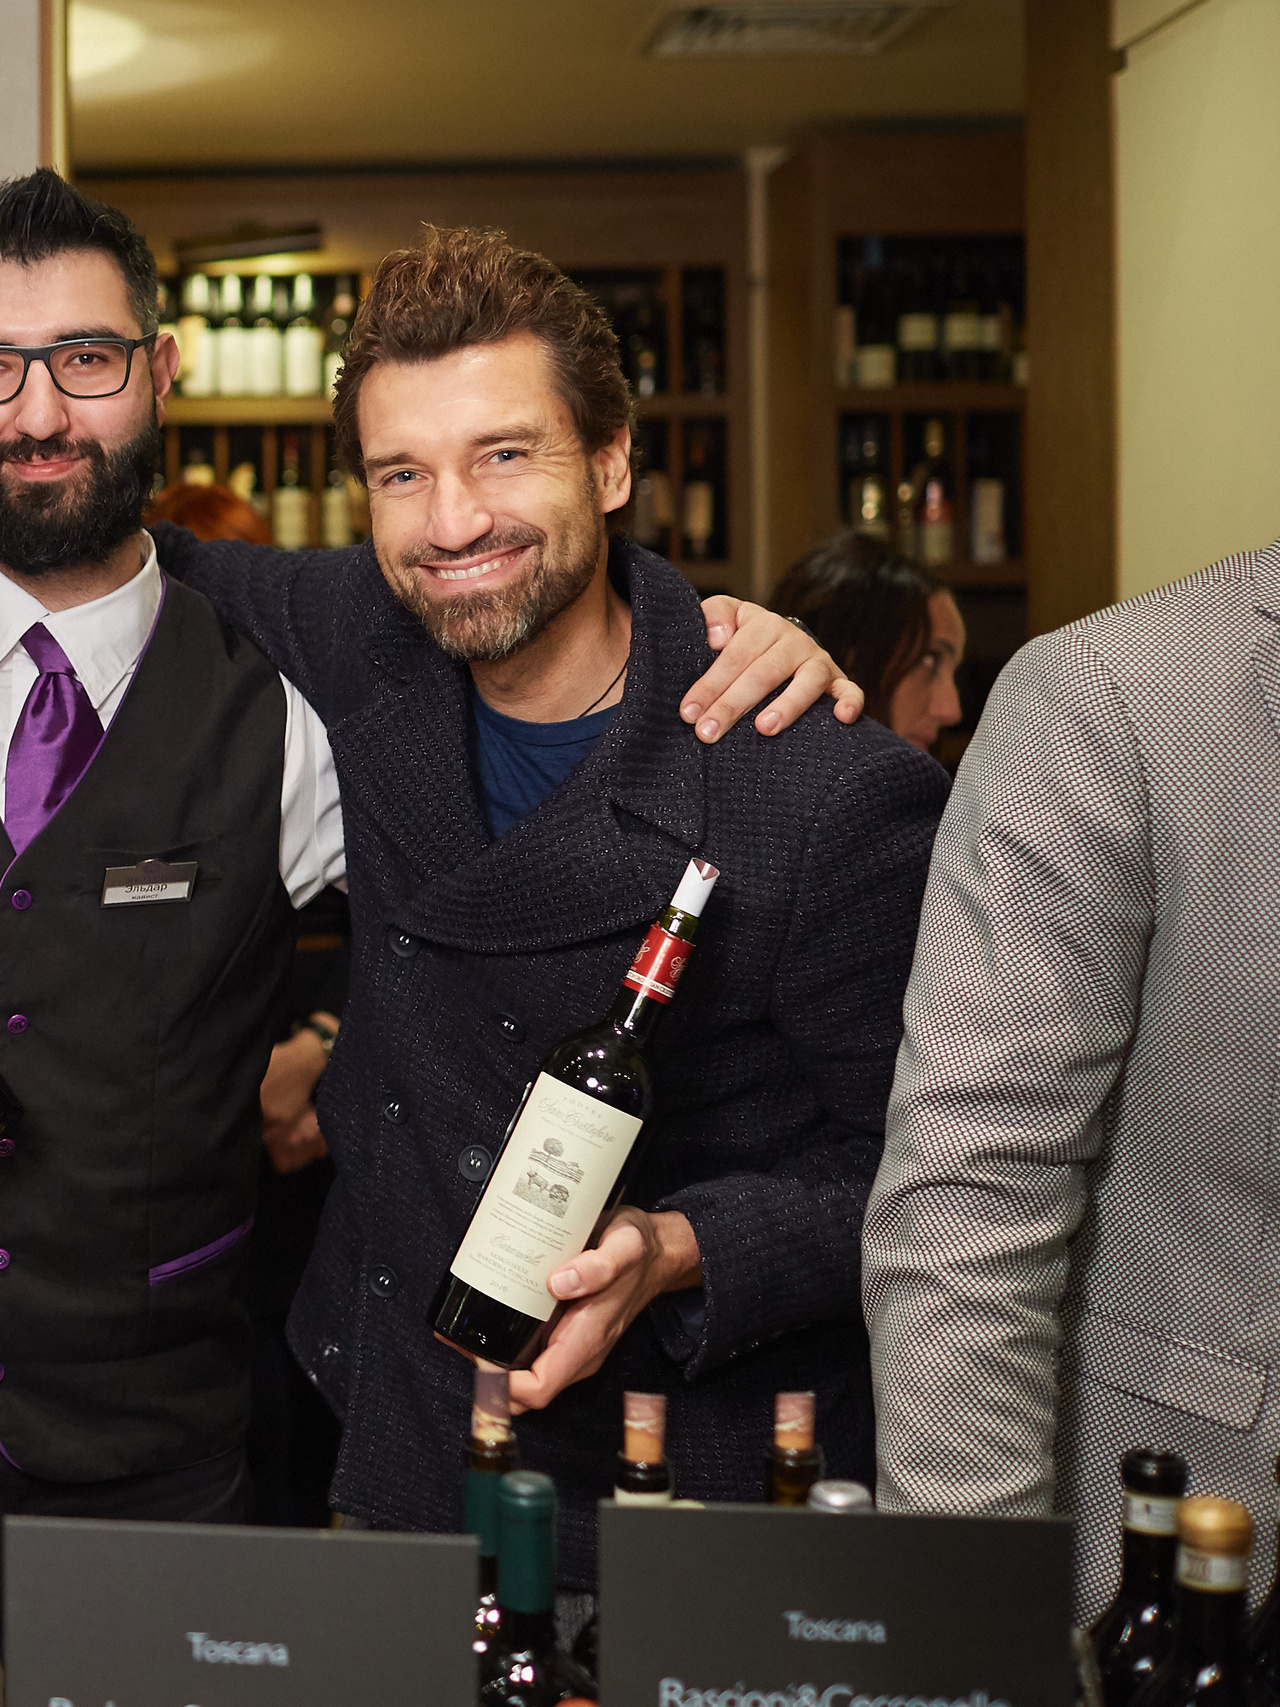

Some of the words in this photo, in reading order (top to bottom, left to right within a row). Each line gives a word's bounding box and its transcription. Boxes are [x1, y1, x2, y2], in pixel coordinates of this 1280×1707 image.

[124, 883, 168, 893] Эльдар
[783, 1610, 887, 1643] Toscana
[186, 1631, 290, 1666] Toscana
